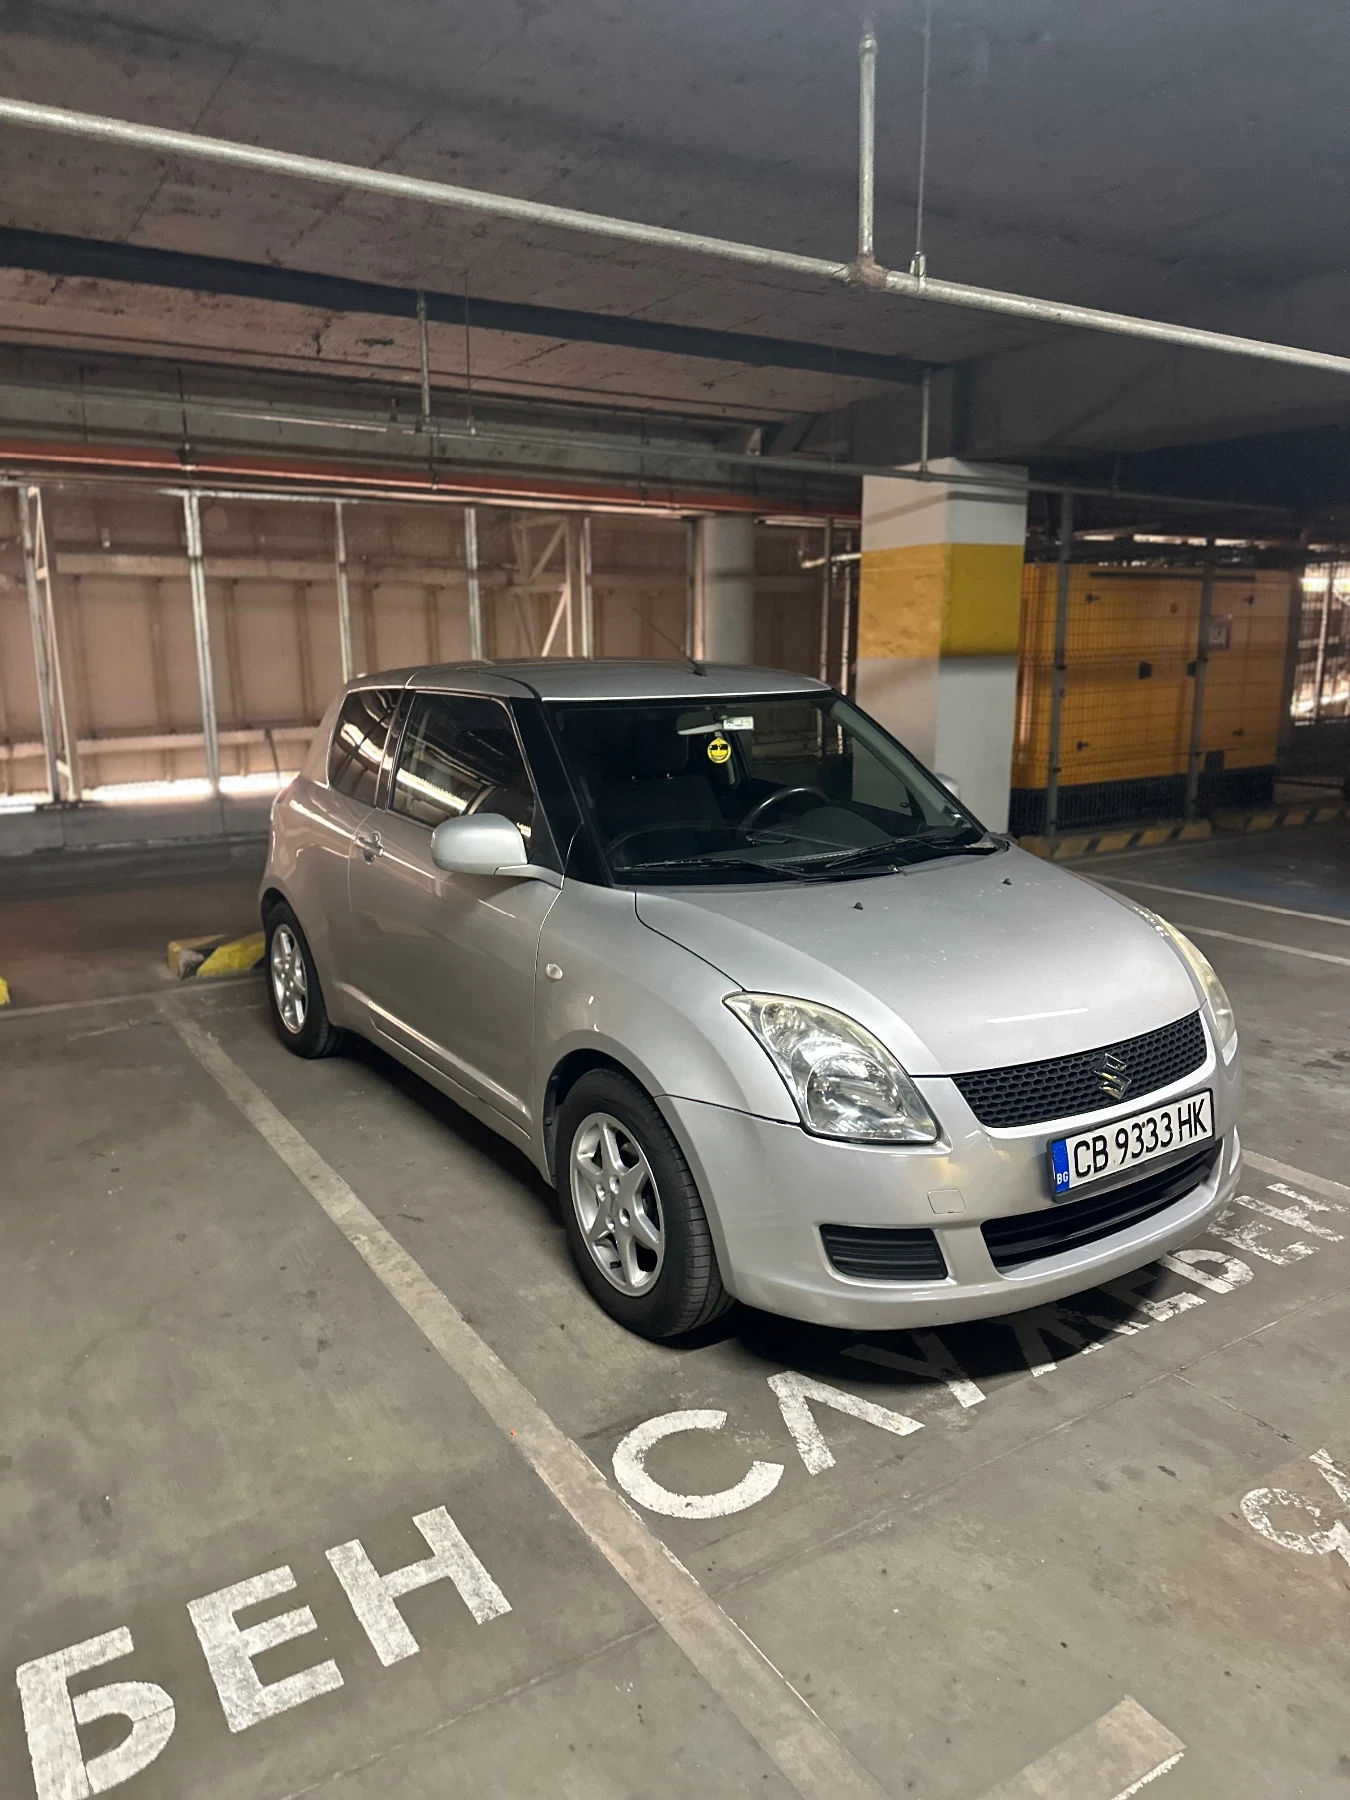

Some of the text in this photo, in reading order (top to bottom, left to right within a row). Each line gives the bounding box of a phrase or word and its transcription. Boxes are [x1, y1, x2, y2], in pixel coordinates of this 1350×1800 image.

[1073, 1098, 1208, 1179] CB 9333 HK
[1056, 1170, 1069, 1186] BG
